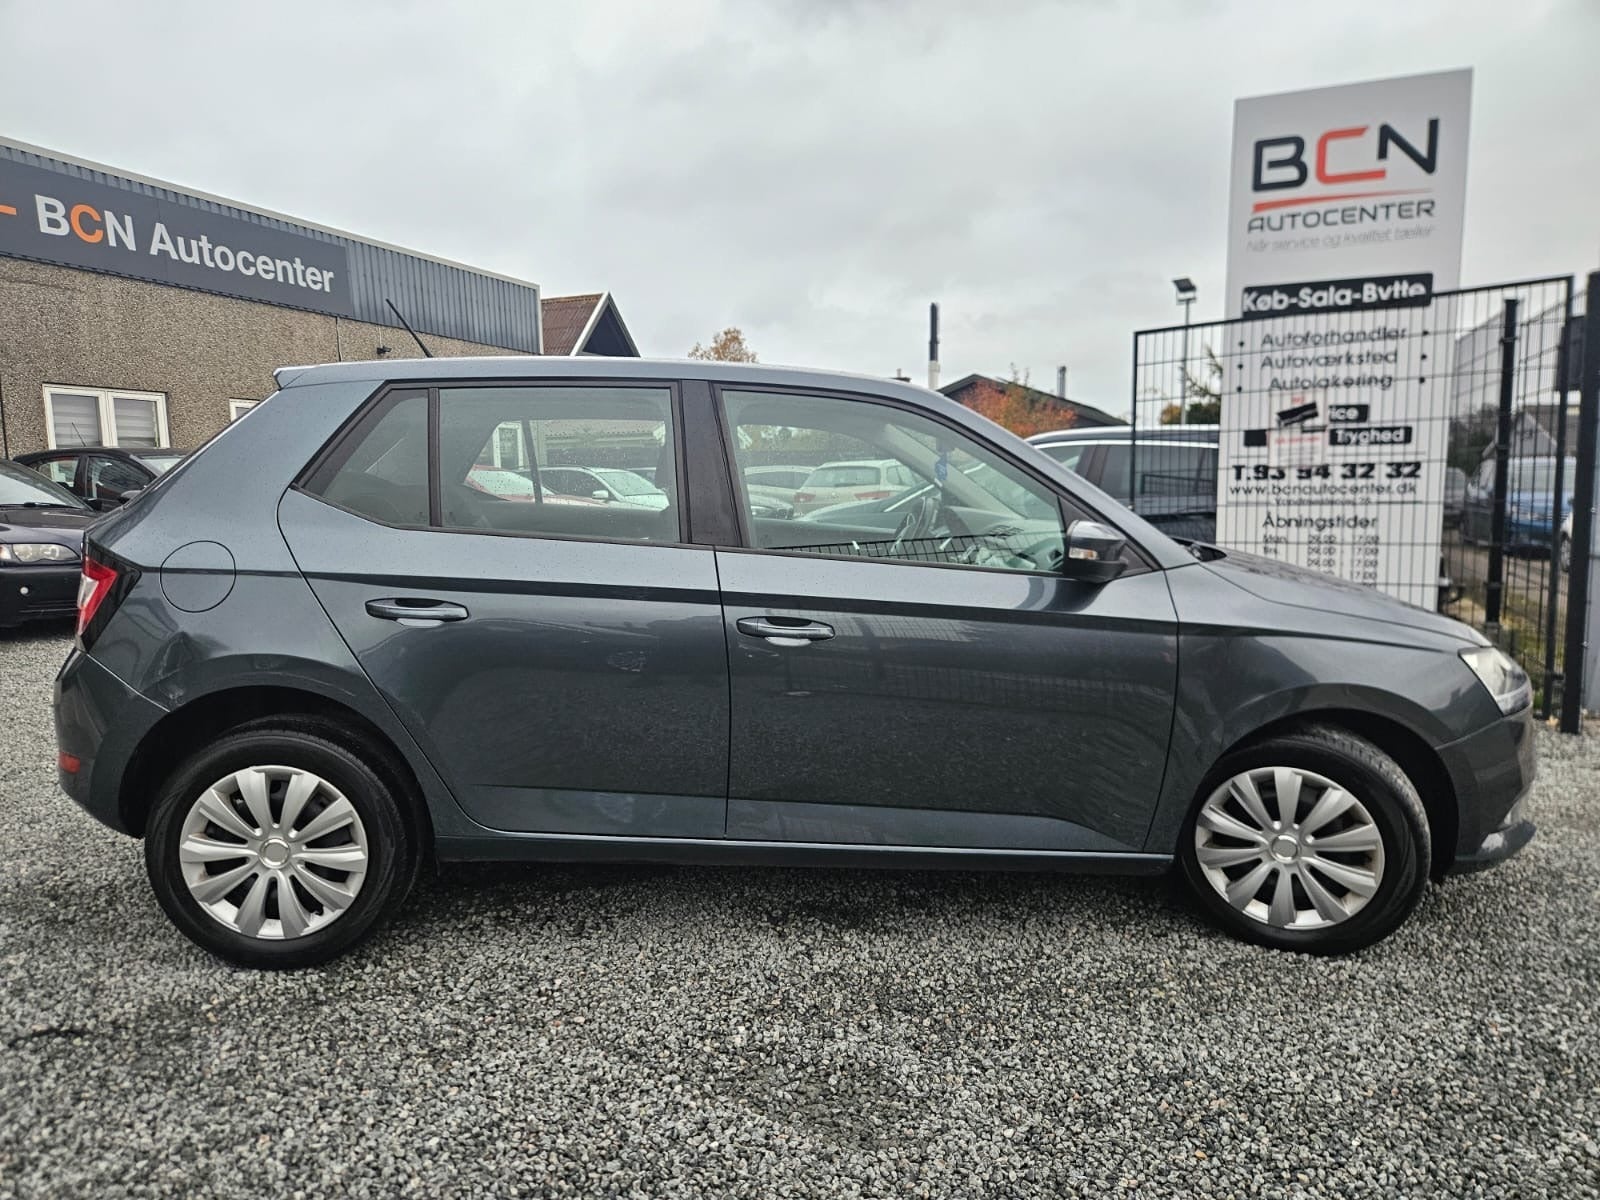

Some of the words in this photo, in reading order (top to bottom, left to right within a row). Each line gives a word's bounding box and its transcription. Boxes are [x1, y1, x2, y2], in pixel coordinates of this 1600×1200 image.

[1252, 117, 1439, 192] BCN
[1248, 199, 1436, 234] AUTOCENTER
[35, 194, 137, 251] BCN
[150, 222, 335, 292] Autocenter
[1261, 326, 1407, 347] Autoforhandler
[1260, 347, 1398, 369] Autoværksted
[1337, 427, 1405, 447] Tryghed
[1341, 462, 1376, 480] 32
[1386, 461, 1421, 479] 32
[1230, 481, 1416, 496] www.bcnautocenter.dk
[1263, 511, 1377, 532] Åbningstider
